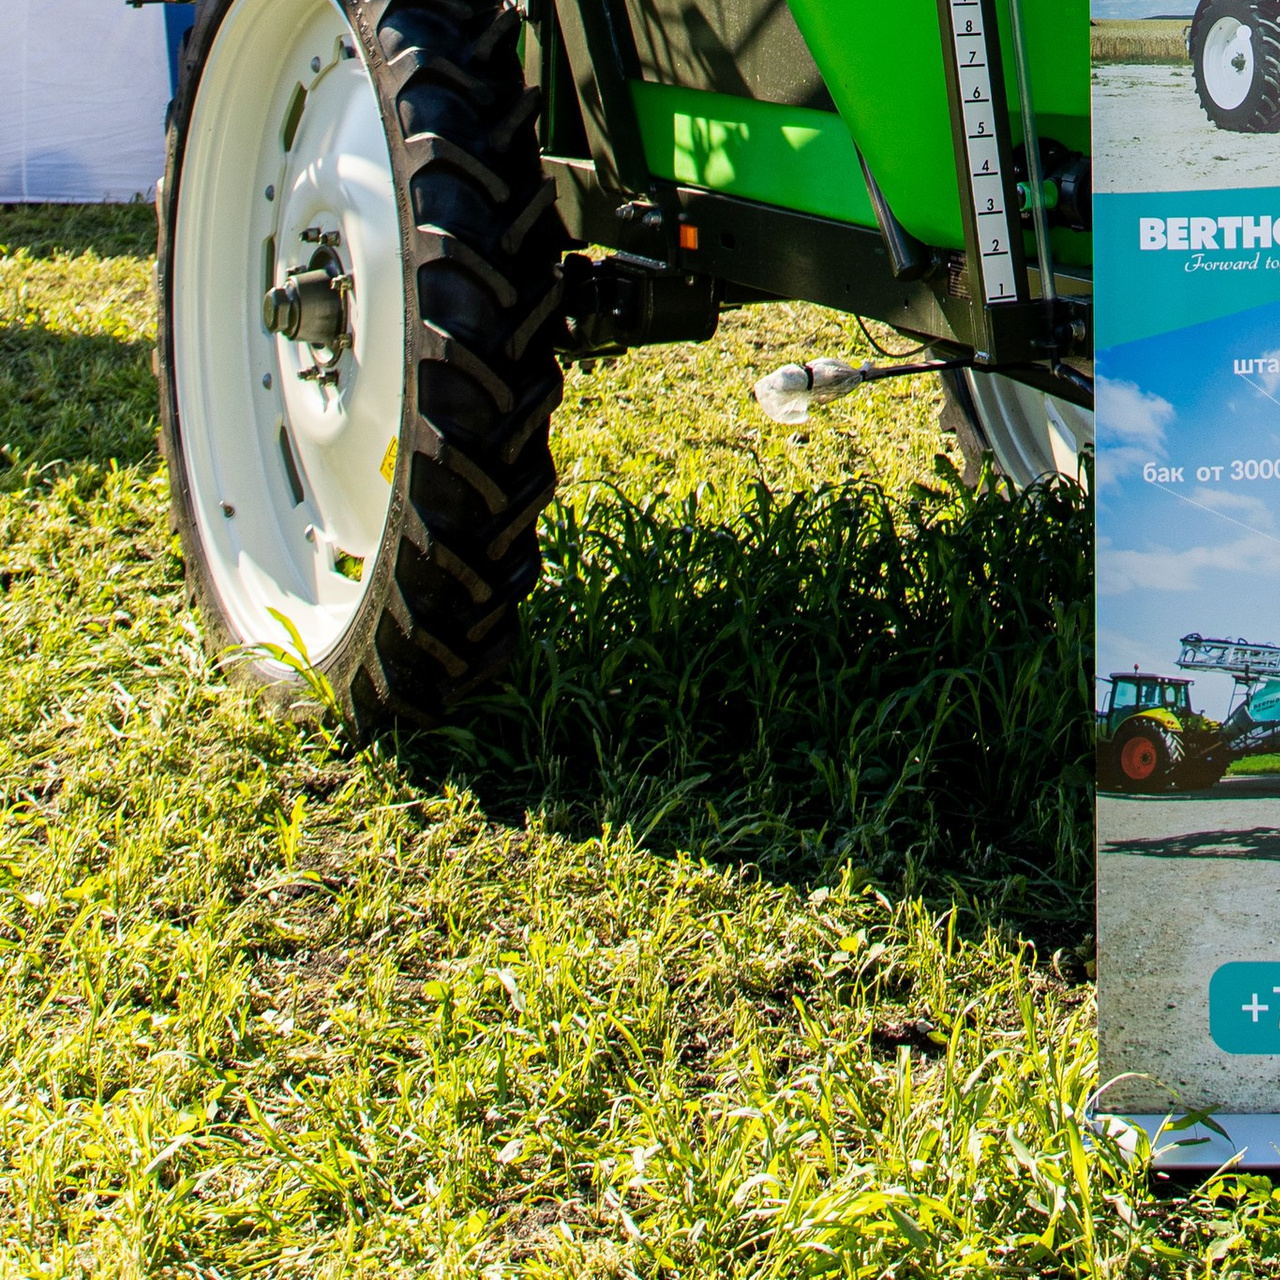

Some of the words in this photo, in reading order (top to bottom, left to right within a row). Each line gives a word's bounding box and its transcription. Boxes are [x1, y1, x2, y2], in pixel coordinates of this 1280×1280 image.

[965, 20, 973, 32] 8
[969, 51, 977, 63] 7
[973, 86, 981, 99] 6
[977, 122, 985, 134] 5
[982, 160, 990, 172] 4
[987, 199, 994, 211] 3
[992, 239, 1000, 251] 2
[1184, 252, 1261, 273] Forward
[998, 283, 1004, 295] 1
[1143, 462, 1185, 483] бак
[1196, 465, 1224, 482] от
